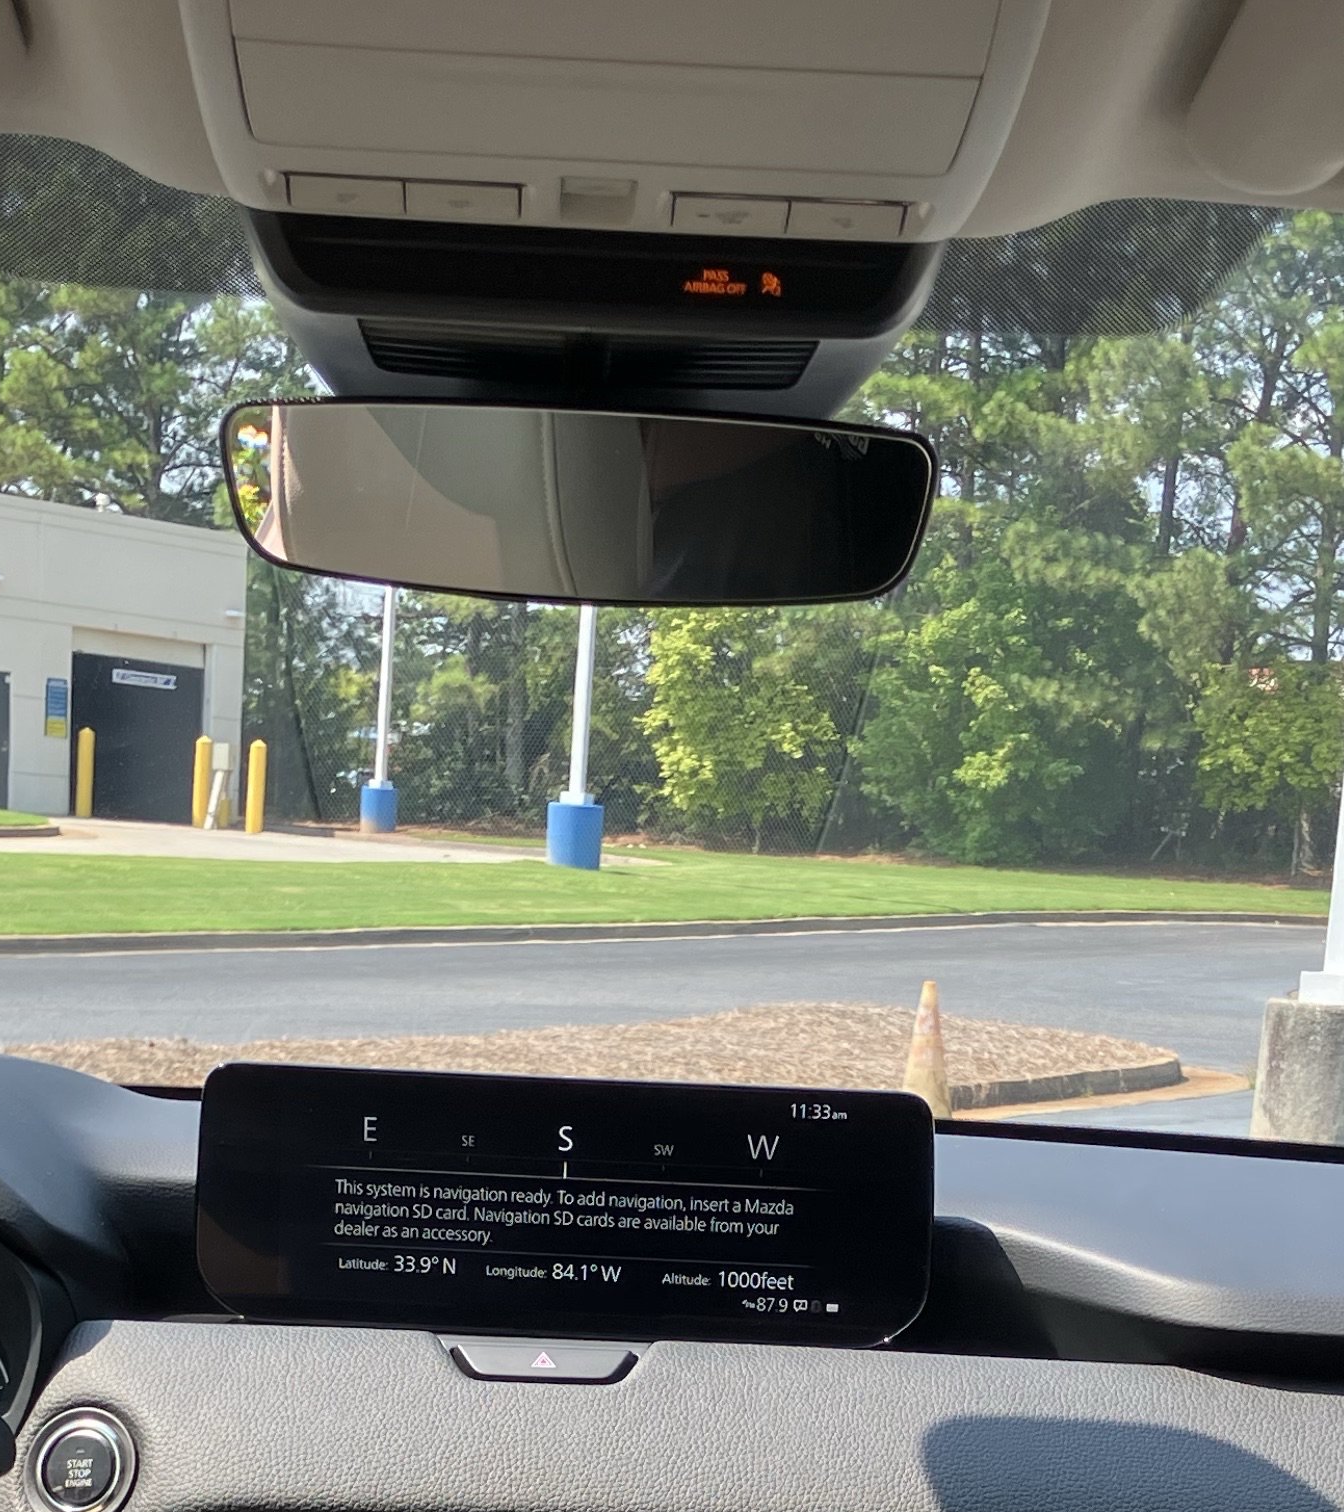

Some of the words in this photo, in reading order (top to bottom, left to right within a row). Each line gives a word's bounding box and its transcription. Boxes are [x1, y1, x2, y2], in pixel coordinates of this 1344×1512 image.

[703, 269, 729, 282] PASS
[684, 281, 725, 293] AIRBAG
[726, 283, 747, 295] OFF
[363, 1116, 378, 1142] E
[558, 1125, 573, 1151] S
[461, 1135, 475, 1147] SE
[747, 1134, 780, 1160] W
[654, 1144, 674, 1157] SW
[335, 1178, 364, 1196] This
[366, 1184, 416, 1199] system
[419, 1184, 431, 1198] is
[433, 1186, 508, 1204] navigation
[510, 1188, 554, 1207] ready.
[557, 1190, 574, 1206] To
[576, 1191, 606, 1207] add
[608, 1194, 687, 1212] navigation,
[689, 1196, 729, 1213] insert
[732, 1201, 742, 1213] a
[745, 1199, 794, 1216] Mazda
[334, 1202, 409, 1220] navigation
[412, 1204, 433, 1219] SD
[435, 1205, 470, 1221] card.
[474, 1207, 550, 1226] Navigation
[553, 1210, 574, 1226] SD
[576, 1212, 615, 1228] cards
[618, 1217, 641, 1229] are
[643, 1214, 707, 1232] available
[710, 1216, 743, 1234] from
[747, 1221, 780, 1238] your
[334, 1219, 380, 1237] dealer
[382, 1225, 399, 1238] as
[401, 1226, 420, 1239] an
[422, 1227, 493, 1246] accessory.
[338, 1257, 389, 1272] Latitude:
[442, 1258, 457, 1275] N
[485, 1265, 548, 1280] Longitude:
[601, 1264, 622, 1282] W
[662, 1273, 712, 1286] Altitude:
[718, 1270, 794, 1291] 1000feet
[756, 1296, 788, 1313] 87.9
[67, 1459, 93, 1469] START
[68, 1469, 91, 1478] STOP
[65, 1478, 92, 1488] ENGINE
